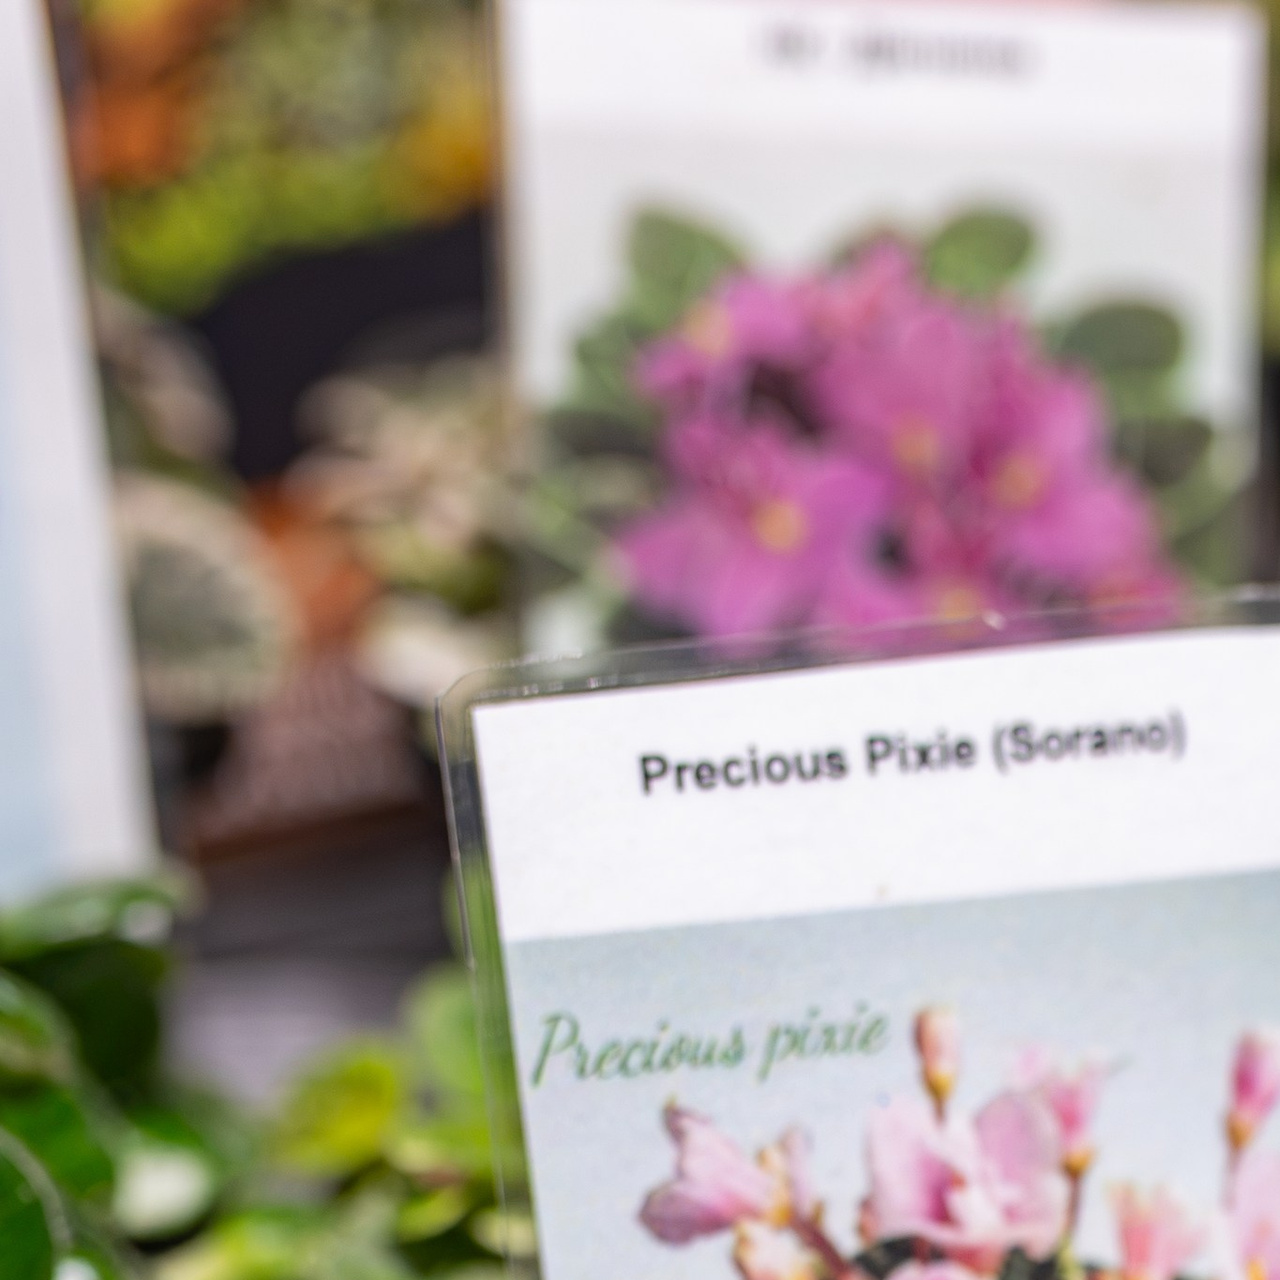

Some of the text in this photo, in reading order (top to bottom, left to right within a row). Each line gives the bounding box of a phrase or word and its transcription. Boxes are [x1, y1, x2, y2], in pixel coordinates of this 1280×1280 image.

[640, 707, 1187, 797] Precious Pixie (Sorano)
[531, 1001, 888, 1088] Precious pixie
